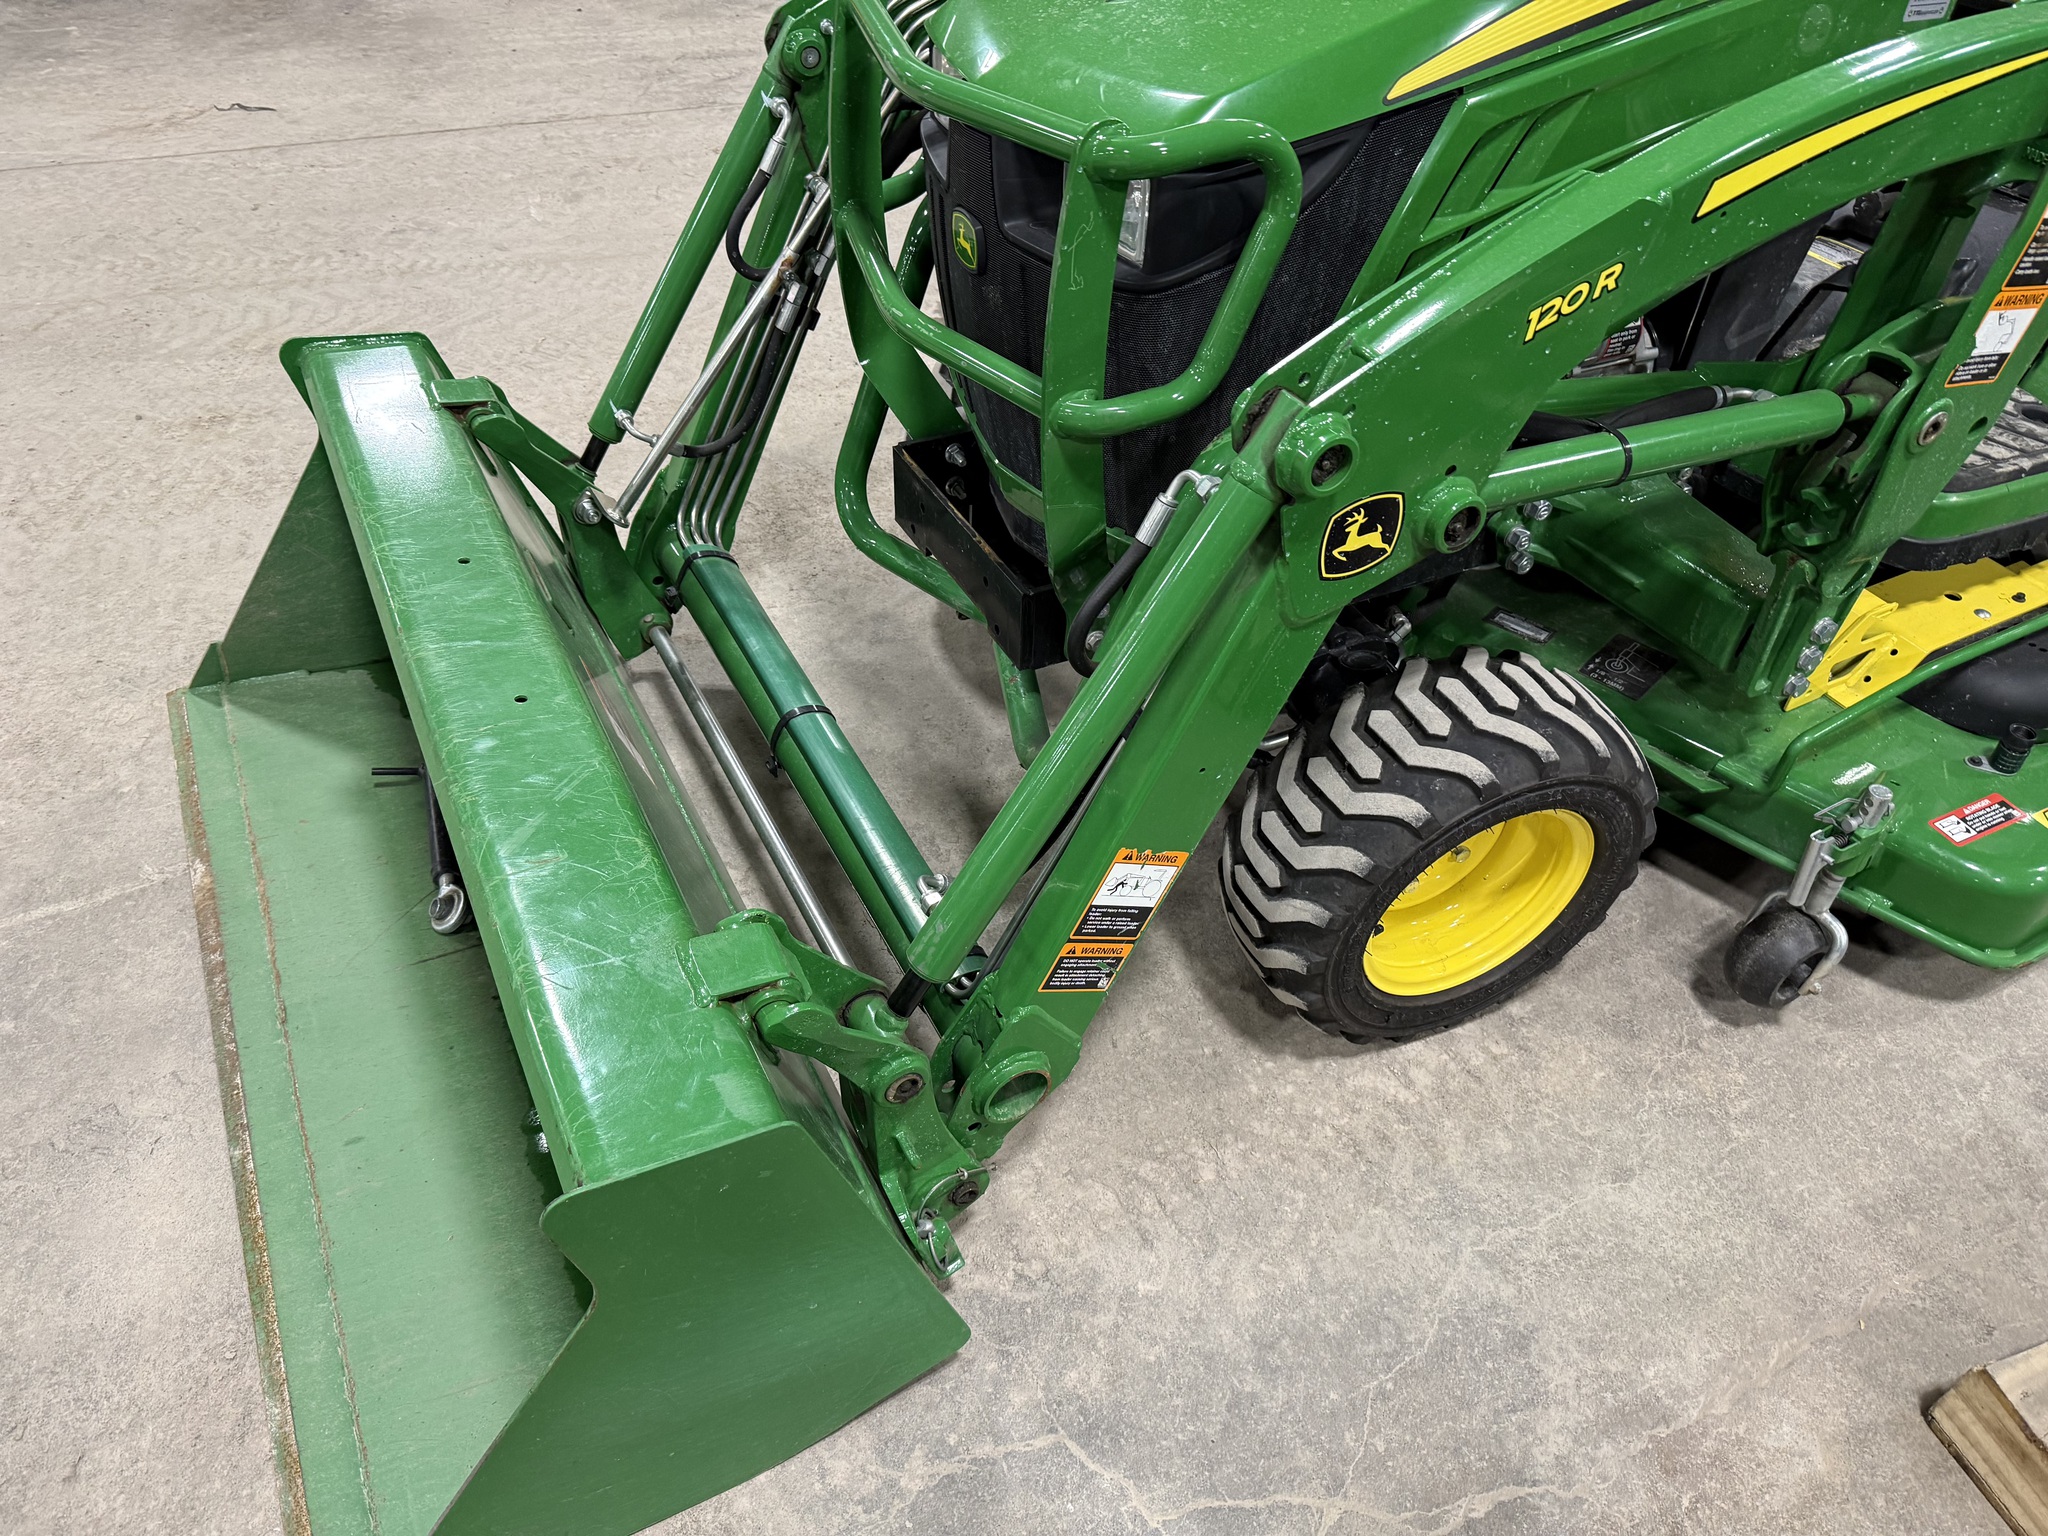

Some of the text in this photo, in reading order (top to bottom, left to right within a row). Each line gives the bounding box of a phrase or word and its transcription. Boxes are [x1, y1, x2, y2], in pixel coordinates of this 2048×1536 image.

[2003, 293, 2045, 306] WARNING
[1967, 799, 1992, 811] DANGER
[1985, 804, 2000, 812] BLADE
[1135, 852, 1178, 863] WARNING
